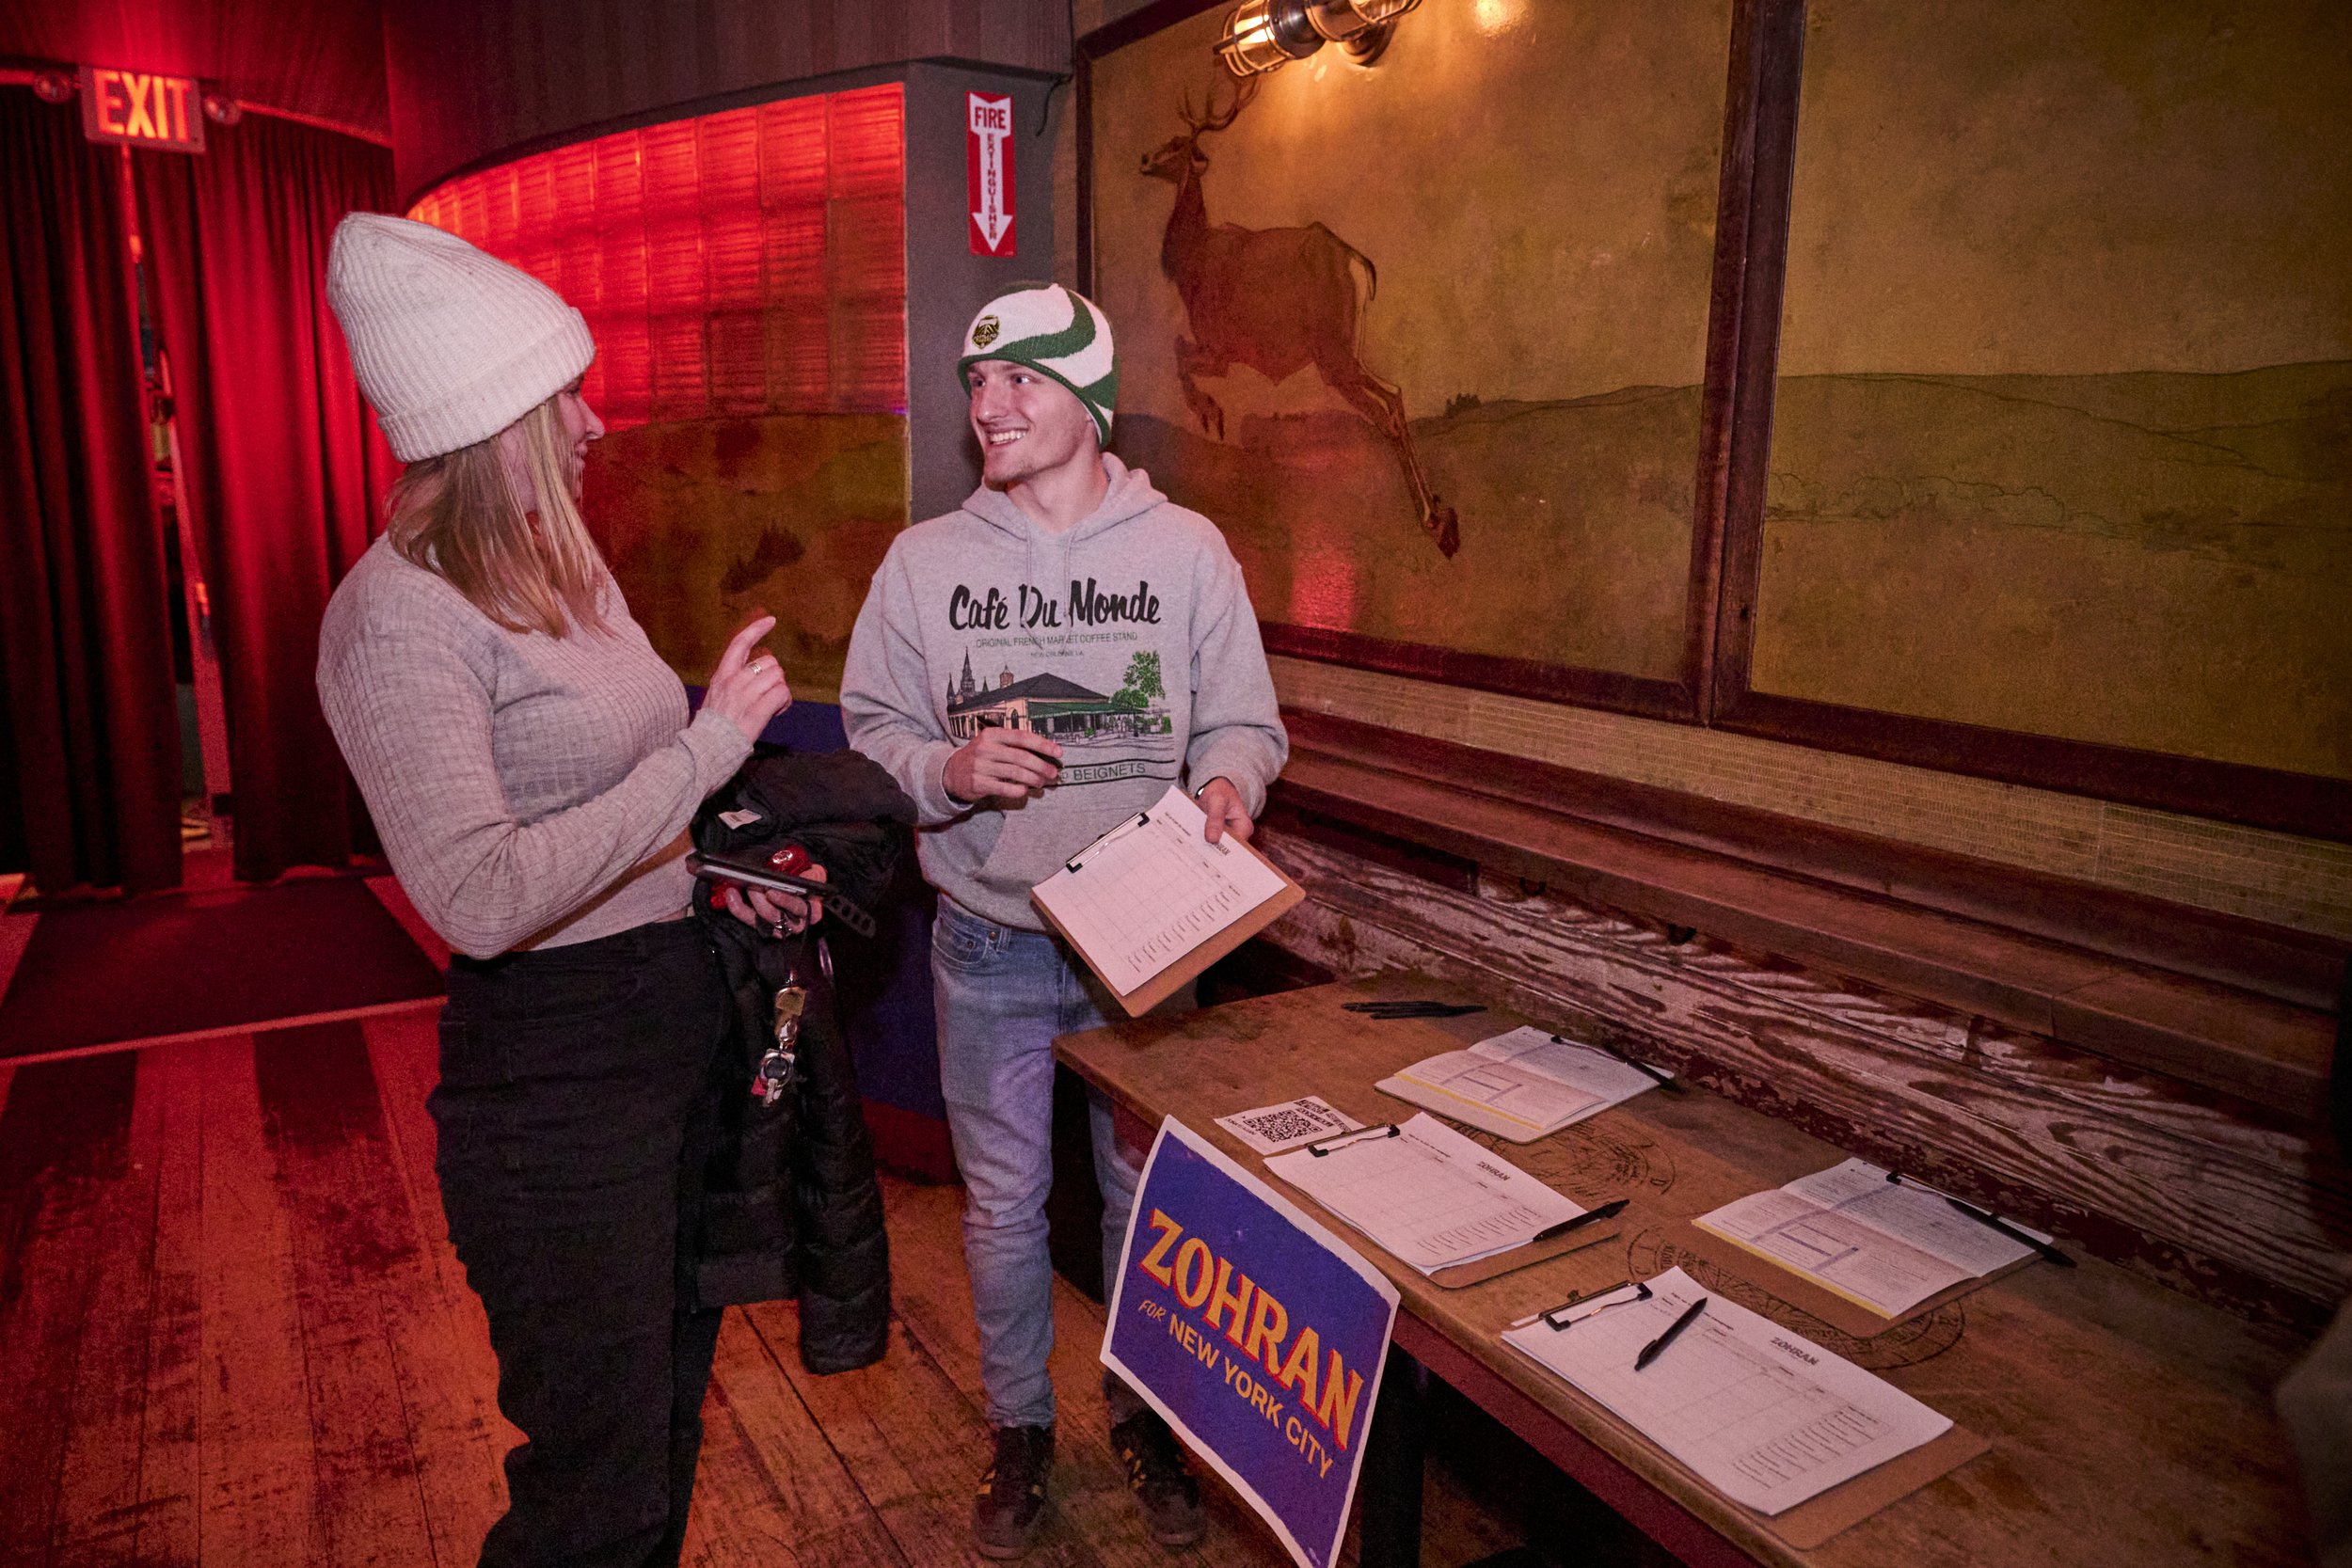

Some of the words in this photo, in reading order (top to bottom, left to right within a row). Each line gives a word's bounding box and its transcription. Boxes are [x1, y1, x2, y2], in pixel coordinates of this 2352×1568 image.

[92, 69, 191, 143] EXIT
[975, 106, 1007, 130] FIRE
[987, 134, 997, 240] EXTINGUISHER
[949, 584, 1010, 630] Café
[1018, 583, 1062, 628] Du
[1069, 578, 1161, 626] Monde
[976, 638, 1011, 648] ORIGINAL
[1013, 636, 1045, 646] FRENCH
[1081, 633, 1112, 643] COFFEE
[1113, 631, 1138, 641] STAND
[1073, 762, 1146, 782] BEIGNETS
[1476, 1161, 1511, 1181] ZOHRAN
[1137, 1208, 1364, 1451] ZOHRAN
[1770, 1336, 1820, 1366] ZOHRAN
[1138, 1300, 1167, 1322] FOR
[1168, 1313, 1220, 1370] NEW
[1225, 1356, 1284, 1429] YORK
[1286, 1416, 1334, 1479] CITY
